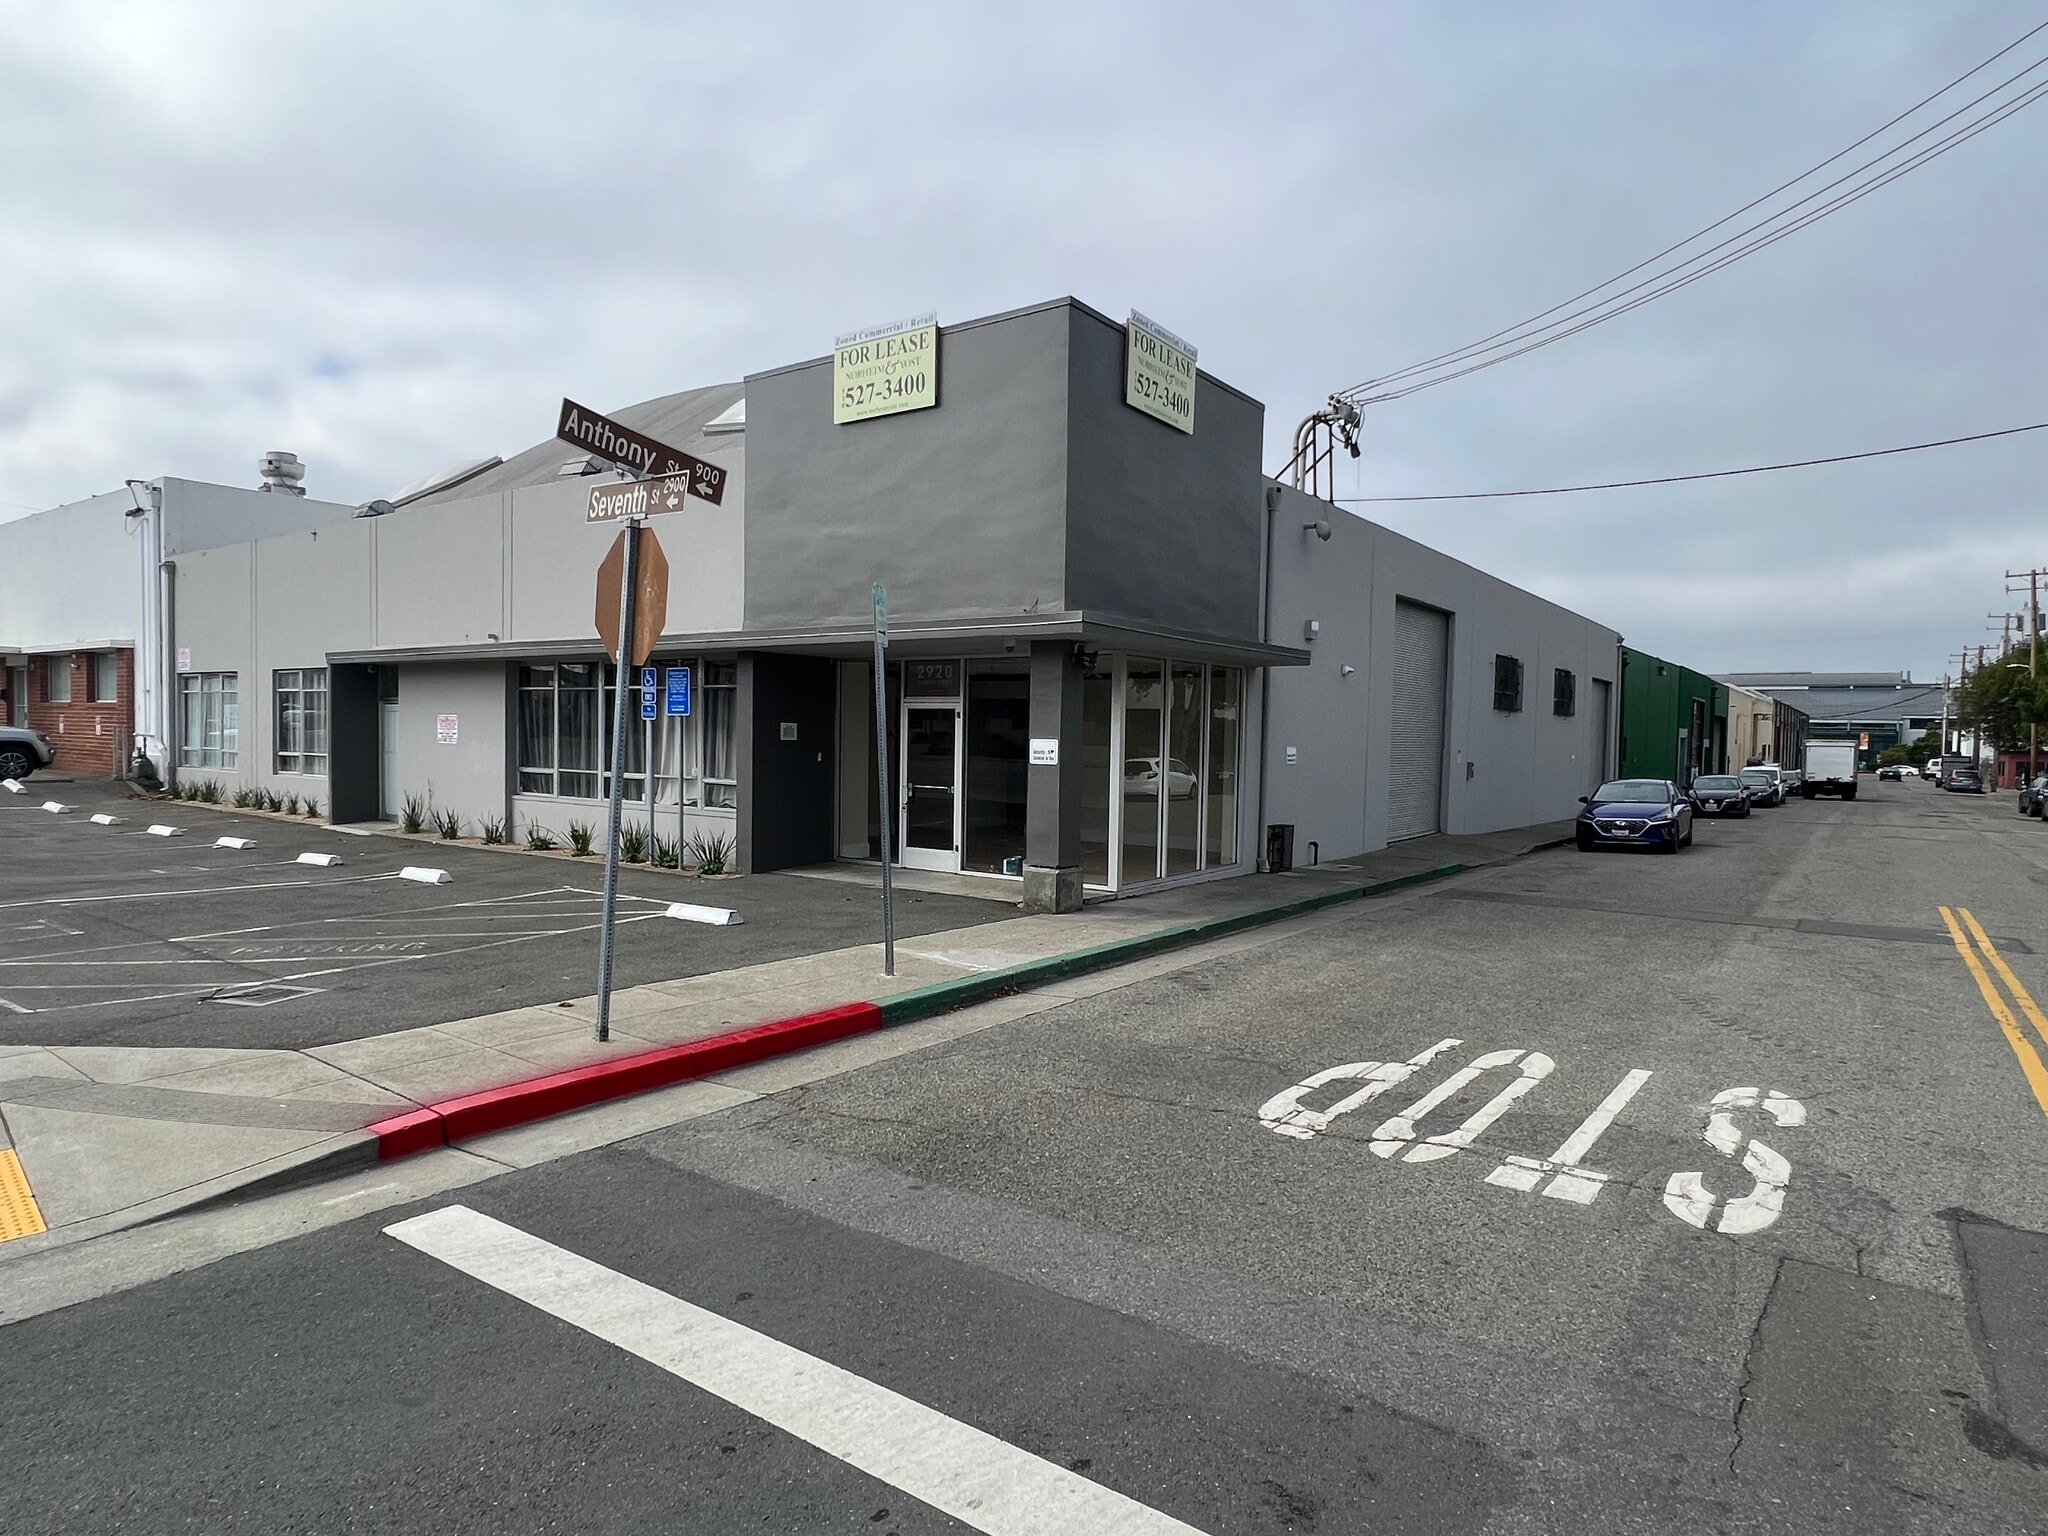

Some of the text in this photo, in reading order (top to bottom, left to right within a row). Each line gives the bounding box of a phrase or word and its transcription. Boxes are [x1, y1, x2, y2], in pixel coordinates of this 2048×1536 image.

[835, 334, 857, 346] Zoned
[859, 322, 904, 340] Commercial
[910, 314, 934, 328] Retail
[840, 331, 930, 368] FOR LEASE
[885, 359, 900, 375] &
[899, 356, 921, 369] YOST
[1134, 329, 1192, 379] FOR LEASE
[845, 371, 926, 408] 527-3400
[1136, 372, 1190, 418] 527-3400
[564, 408, 720, 485] Anthony St 900
[589, 475, 686, 519] Seventh St 2900
[917, 665, 953, 679] 2920
[1258, 1038, 1807, 1235] STOP
